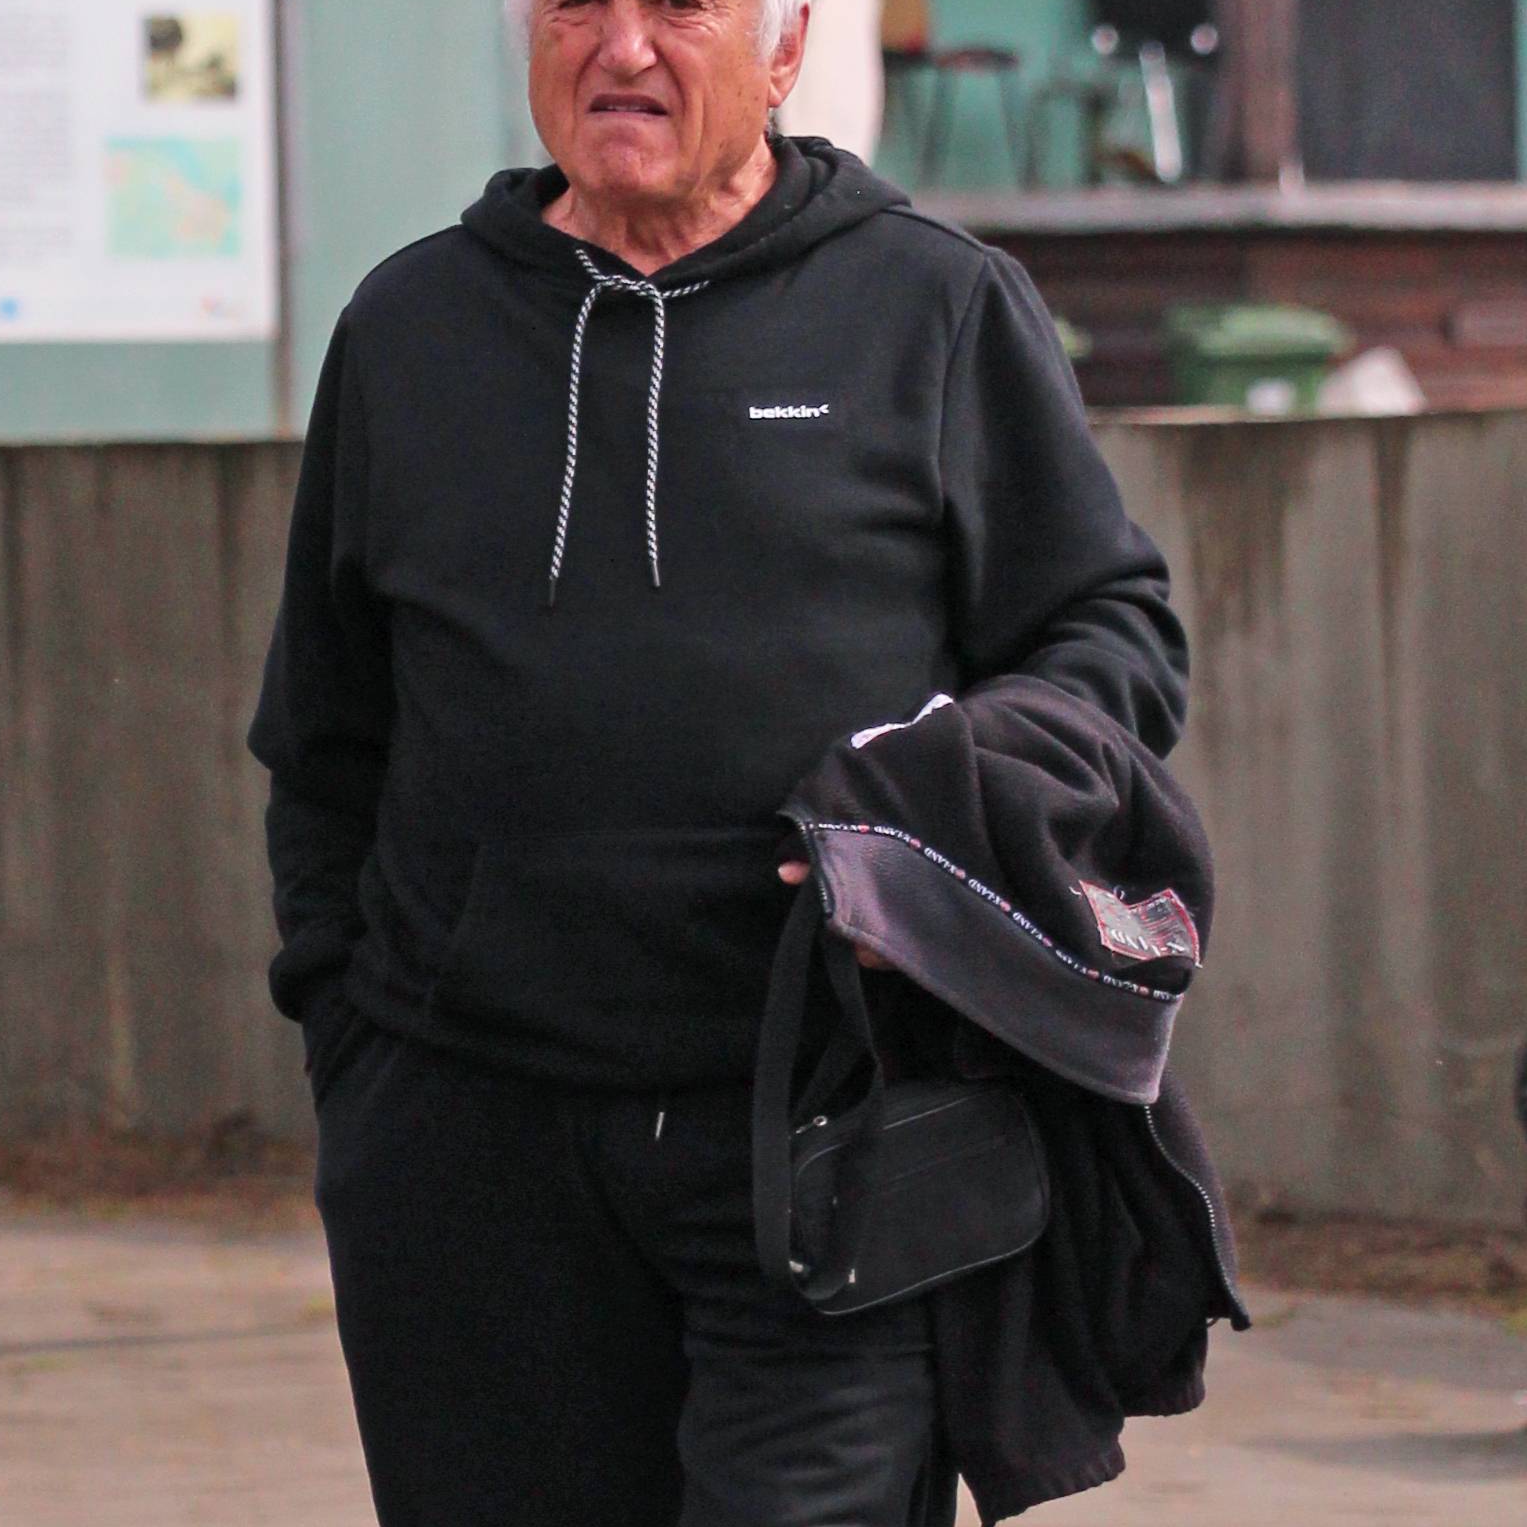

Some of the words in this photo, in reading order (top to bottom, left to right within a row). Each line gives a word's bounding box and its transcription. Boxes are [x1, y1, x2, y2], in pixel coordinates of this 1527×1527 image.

[924, 846, 957, 874] X-LAND
[968, 877, 1002, 905] X-LAND
[1012, 911, 1043, 940] X-LAND
